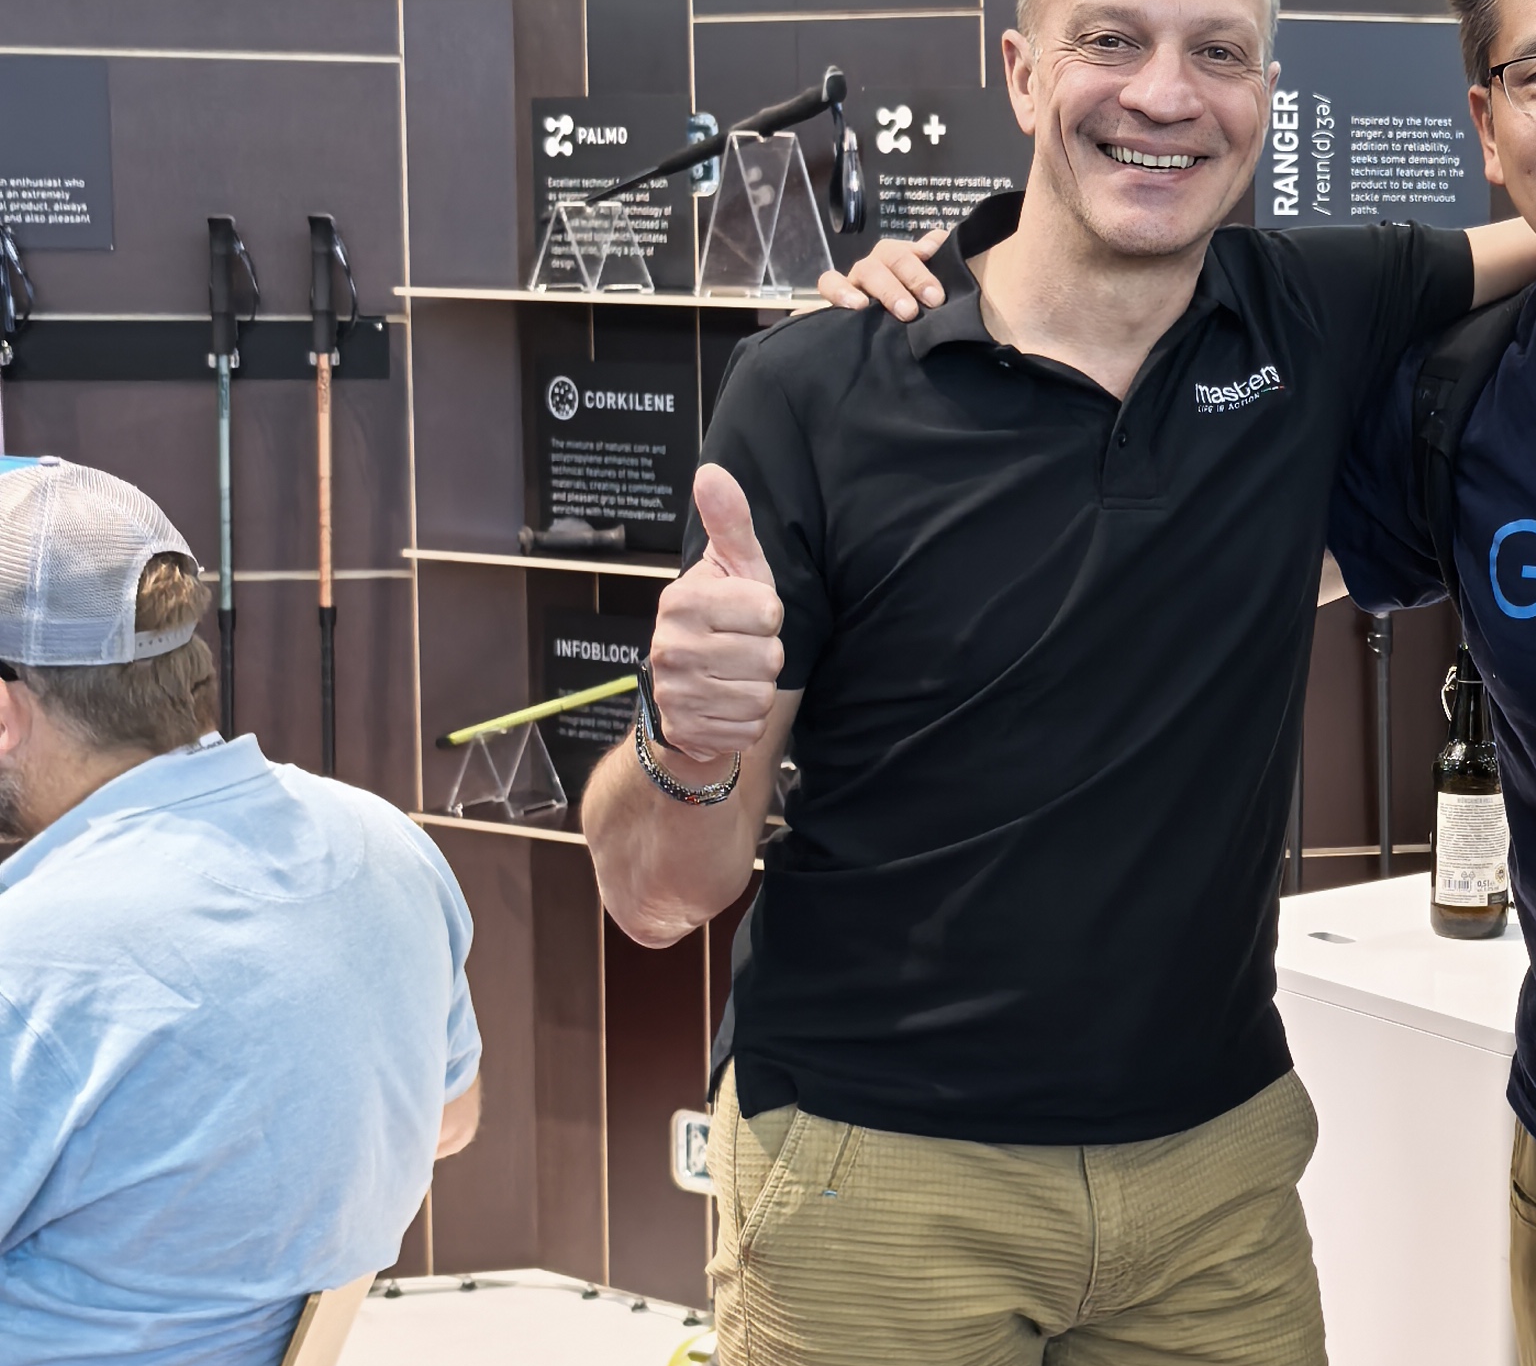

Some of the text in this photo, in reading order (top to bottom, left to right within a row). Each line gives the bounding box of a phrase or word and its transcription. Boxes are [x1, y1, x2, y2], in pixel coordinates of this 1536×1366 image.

[1351, 116, 1452, 127] Inspired by the forest
[577, 126, 628, 144] PALMO
[1396, 131, 1429, 140] person
[1456, 130, 1464, 139] in
[1351, 142, 1388, 151] addition
[1392, 143, 1400, 151] to
[1273, 91, 1299, 216] RANGER
[1351, 155, 1378, 164] seeks
[1408, 155, 1460, 166] demanding
[1351, 167, 1464, 177] technical features in the
[10, 177, 61, 187] enthusiast
[64, 177, 85, 188] who
[548, 177, 580, 188] Excellent
[582, 178, 615, 189] technical
[651, 179, 668, 188] such
[880, 175, 893, 185] For
[896, 177, 906, 185] an
[908, 177, 928, 187] even
[930, 177, 951, 187] more
[955, 176, 991, 187] versatile
[1351, 180, 1448, 190] product to be able to
[21, 190, 70, 200] extremely
[880, 190, 950, 201] some models are
[1351, 193, 1456, 203] tackle more strenuous
[880, 204, 896, 214] EVA
[942, 206, 960, 216] now
[1351, 206, 1379, 215] paths.
[4, 213, 91, 224] and also pleasant
[1195, 365, 1280, 404] masters
[585, 391, 675, 412] CORKILENE
[556, 639, 639, 664] INFOBLOCK
